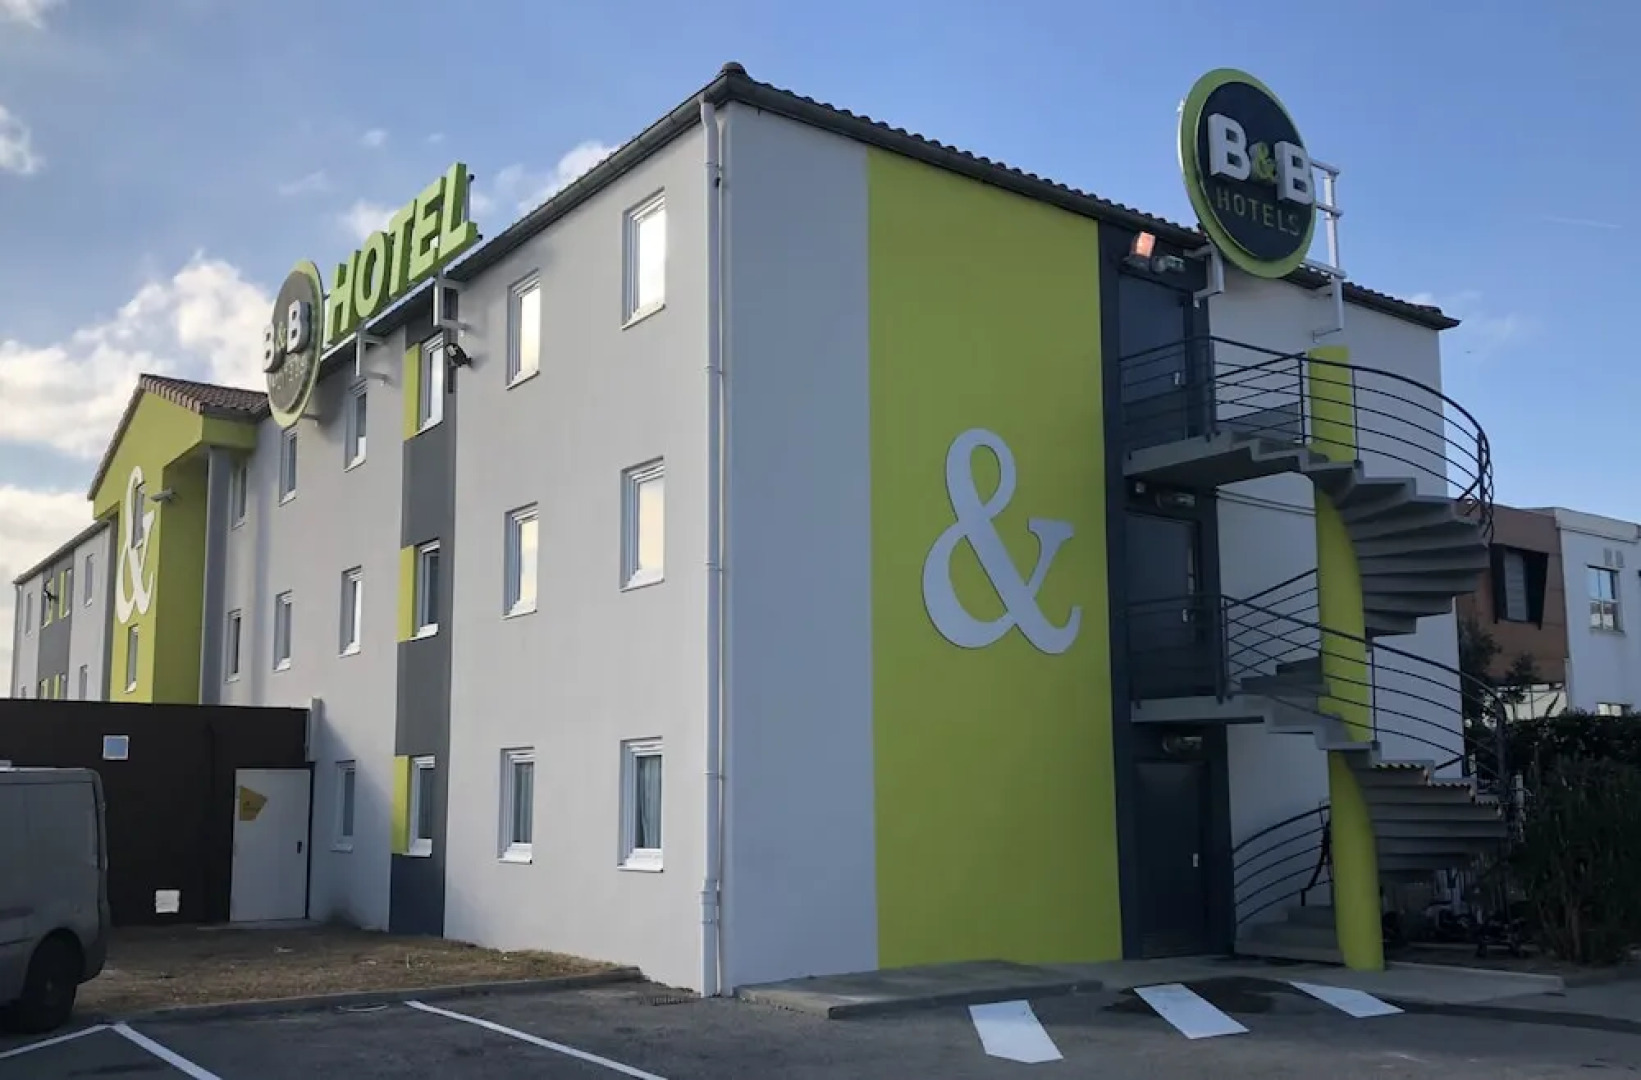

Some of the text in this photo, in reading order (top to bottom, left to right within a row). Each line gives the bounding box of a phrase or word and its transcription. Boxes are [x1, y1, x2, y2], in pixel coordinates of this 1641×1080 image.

[1208, 113, 1315, 204] B&B
[1216, 187, 1299, 236] HOTELS
[327, 162, 477, 345] HOTEL
[263, 299, 311, 373] B&B
[117, 466, 155, 624] &
[922, 428, 1082, 655] &
